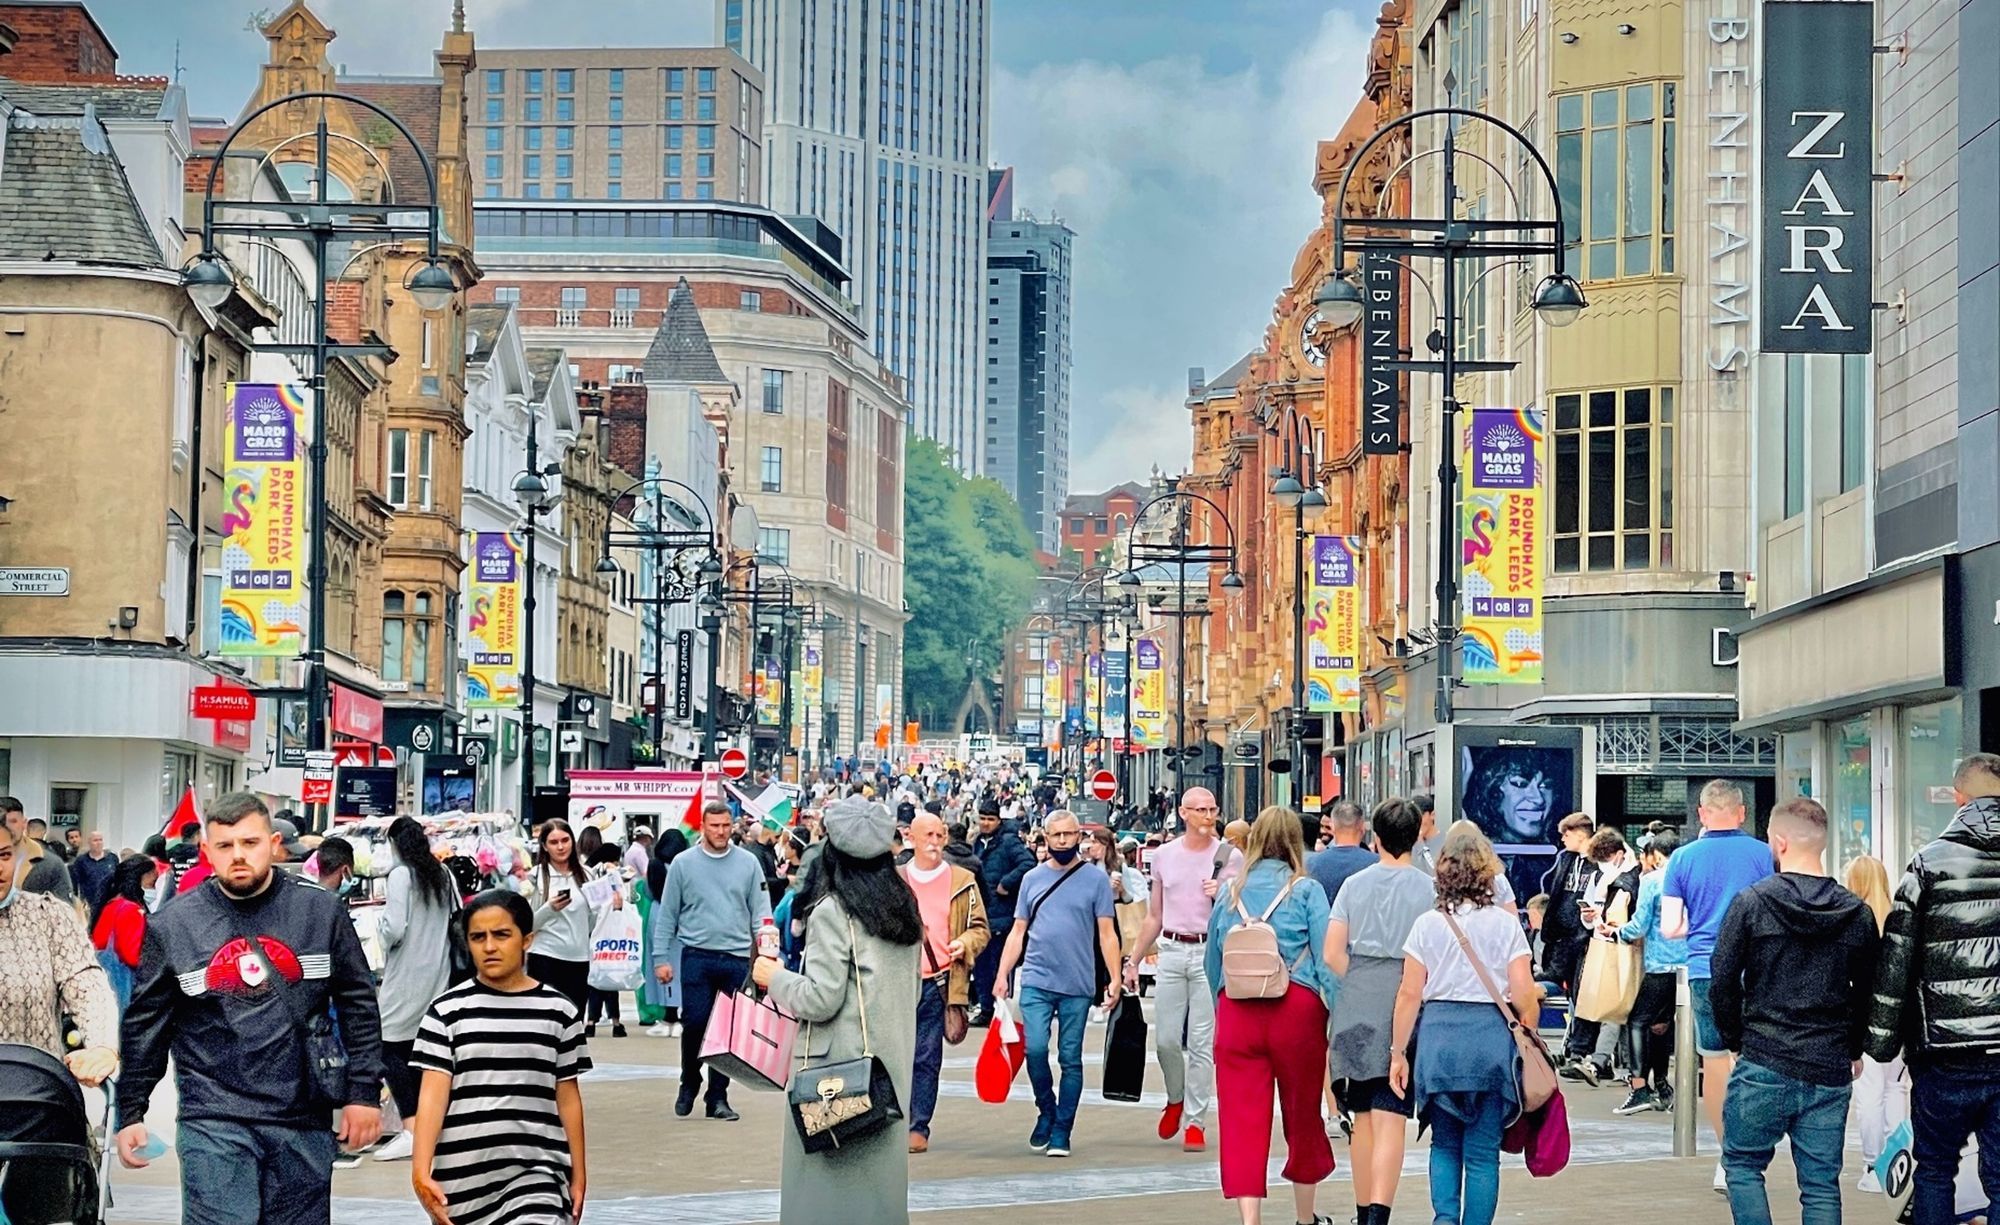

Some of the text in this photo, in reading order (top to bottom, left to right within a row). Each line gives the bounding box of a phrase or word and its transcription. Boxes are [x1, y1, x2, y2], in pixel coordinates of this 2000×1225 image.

[1780, 111, 1854, 330] ZARA
[243, 426, 286, 437] MARDI
[246, 438, 282, 448] GRAS
[1482, 453, 1525, 463] MARDI
[1485, 464, 1522, 475] GRAS
[281, 470, 294, 561] ROUNDHAY
[267, 519, 280, 564] LEEDS
[1522, 497, 1534, 589] ROUNDHAY
[481, 559, 510, 567] MARDI
[1320, 563, 1348, 571] MARDI
[1508, 546, 1520, 593] LEEDS
[0, 571, 63, 580] COMMERCIAL
[235, 575, 288, 585] 14 08 21
[12, 582, 49, 591] STREET
[1476, 602, 1529, 613] 14 08 21
[506, 588, 514, 647] ROUNDHAY
[1345, 592, 1353, 651] ROUNDHAY
[476, 655, 485, 663] 14
[502, 655, 511, 663] 21
[200, 696, 249, 705] H.SAMUEL
[614, 783, 631, 792] MR
[633, 783, 672, 792] WHIPPY
[595, 940, 639, 952] SPORTS
